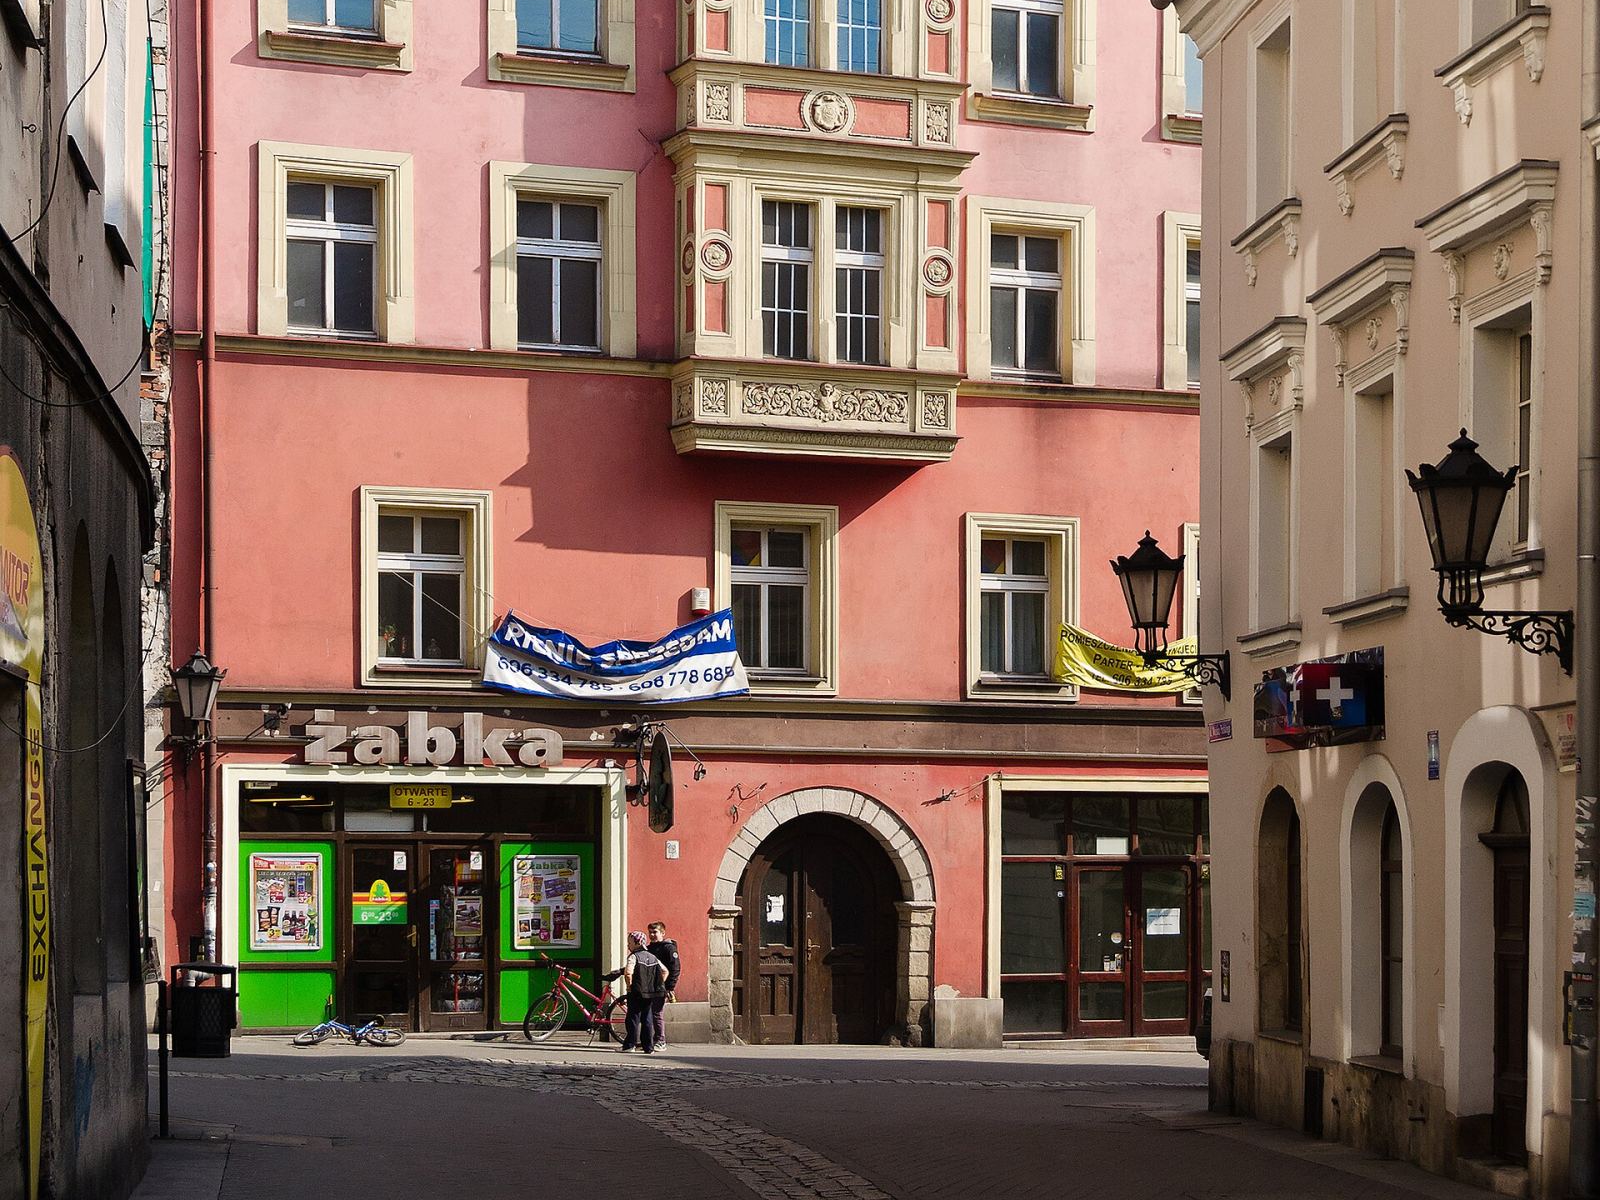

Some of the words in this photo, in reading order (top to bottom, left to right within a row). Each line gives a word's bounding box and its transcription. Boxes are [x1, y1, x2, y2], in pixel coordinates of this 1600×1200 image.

[0, 546, 28, 607] NTOR
[1093, 654, 1134, 670] PARTER
[537, 667, 573, 686] 334
[577, 677, 614, 691] 785
[668, 669, 698, 687] 778
[703, 666, 735, 683] 685
[304, 709, 564, 766] żabka
[394, 787, 448, 797] OTWARTE
[407, 797, 414, 807] 6
[423, 797, 435, 807] 23
[30, 728, 47, 982] EXCHANGE
